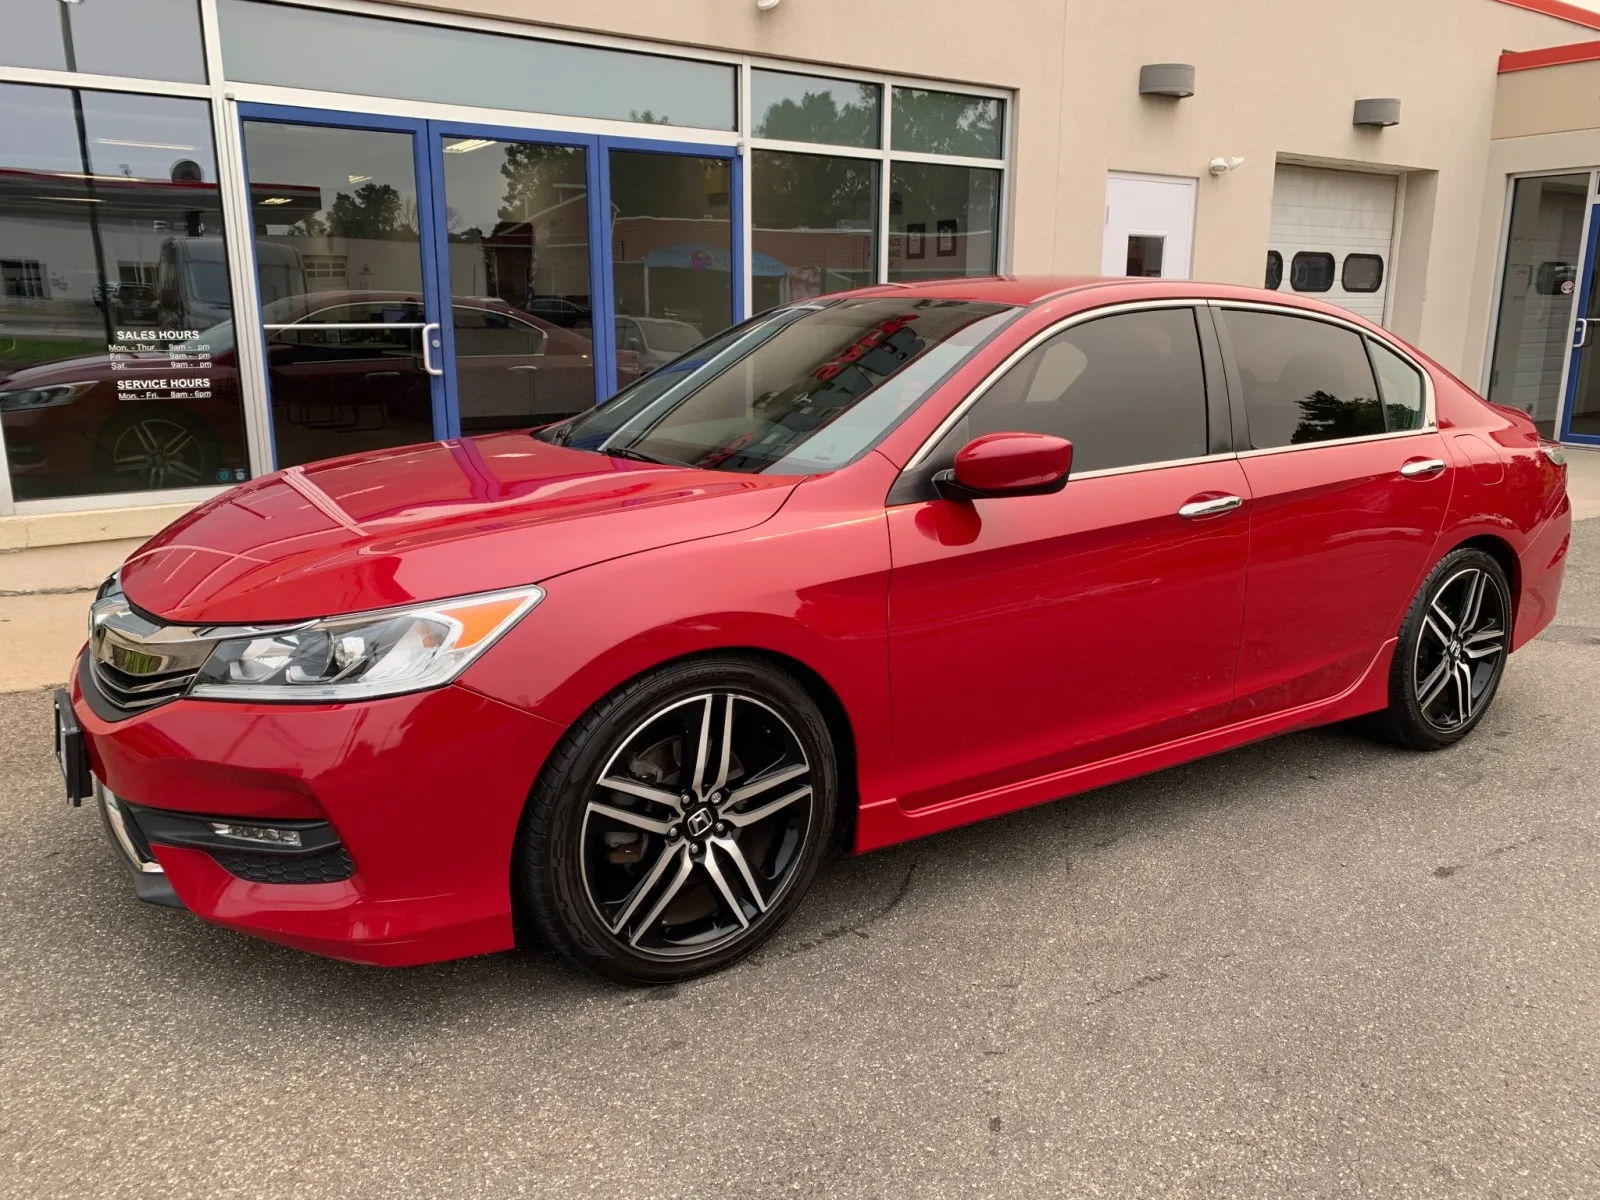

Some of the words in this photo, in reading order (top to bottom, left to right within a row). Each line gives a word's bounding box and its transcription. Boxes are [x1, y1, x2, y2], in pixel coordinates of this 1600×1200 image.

[117, 330, 156, 339] SALES
[159, 330, 199, 339] HOURS
[117, 379, 167, 389] SERVICE
[170, 378, 210, 387] HOURS
